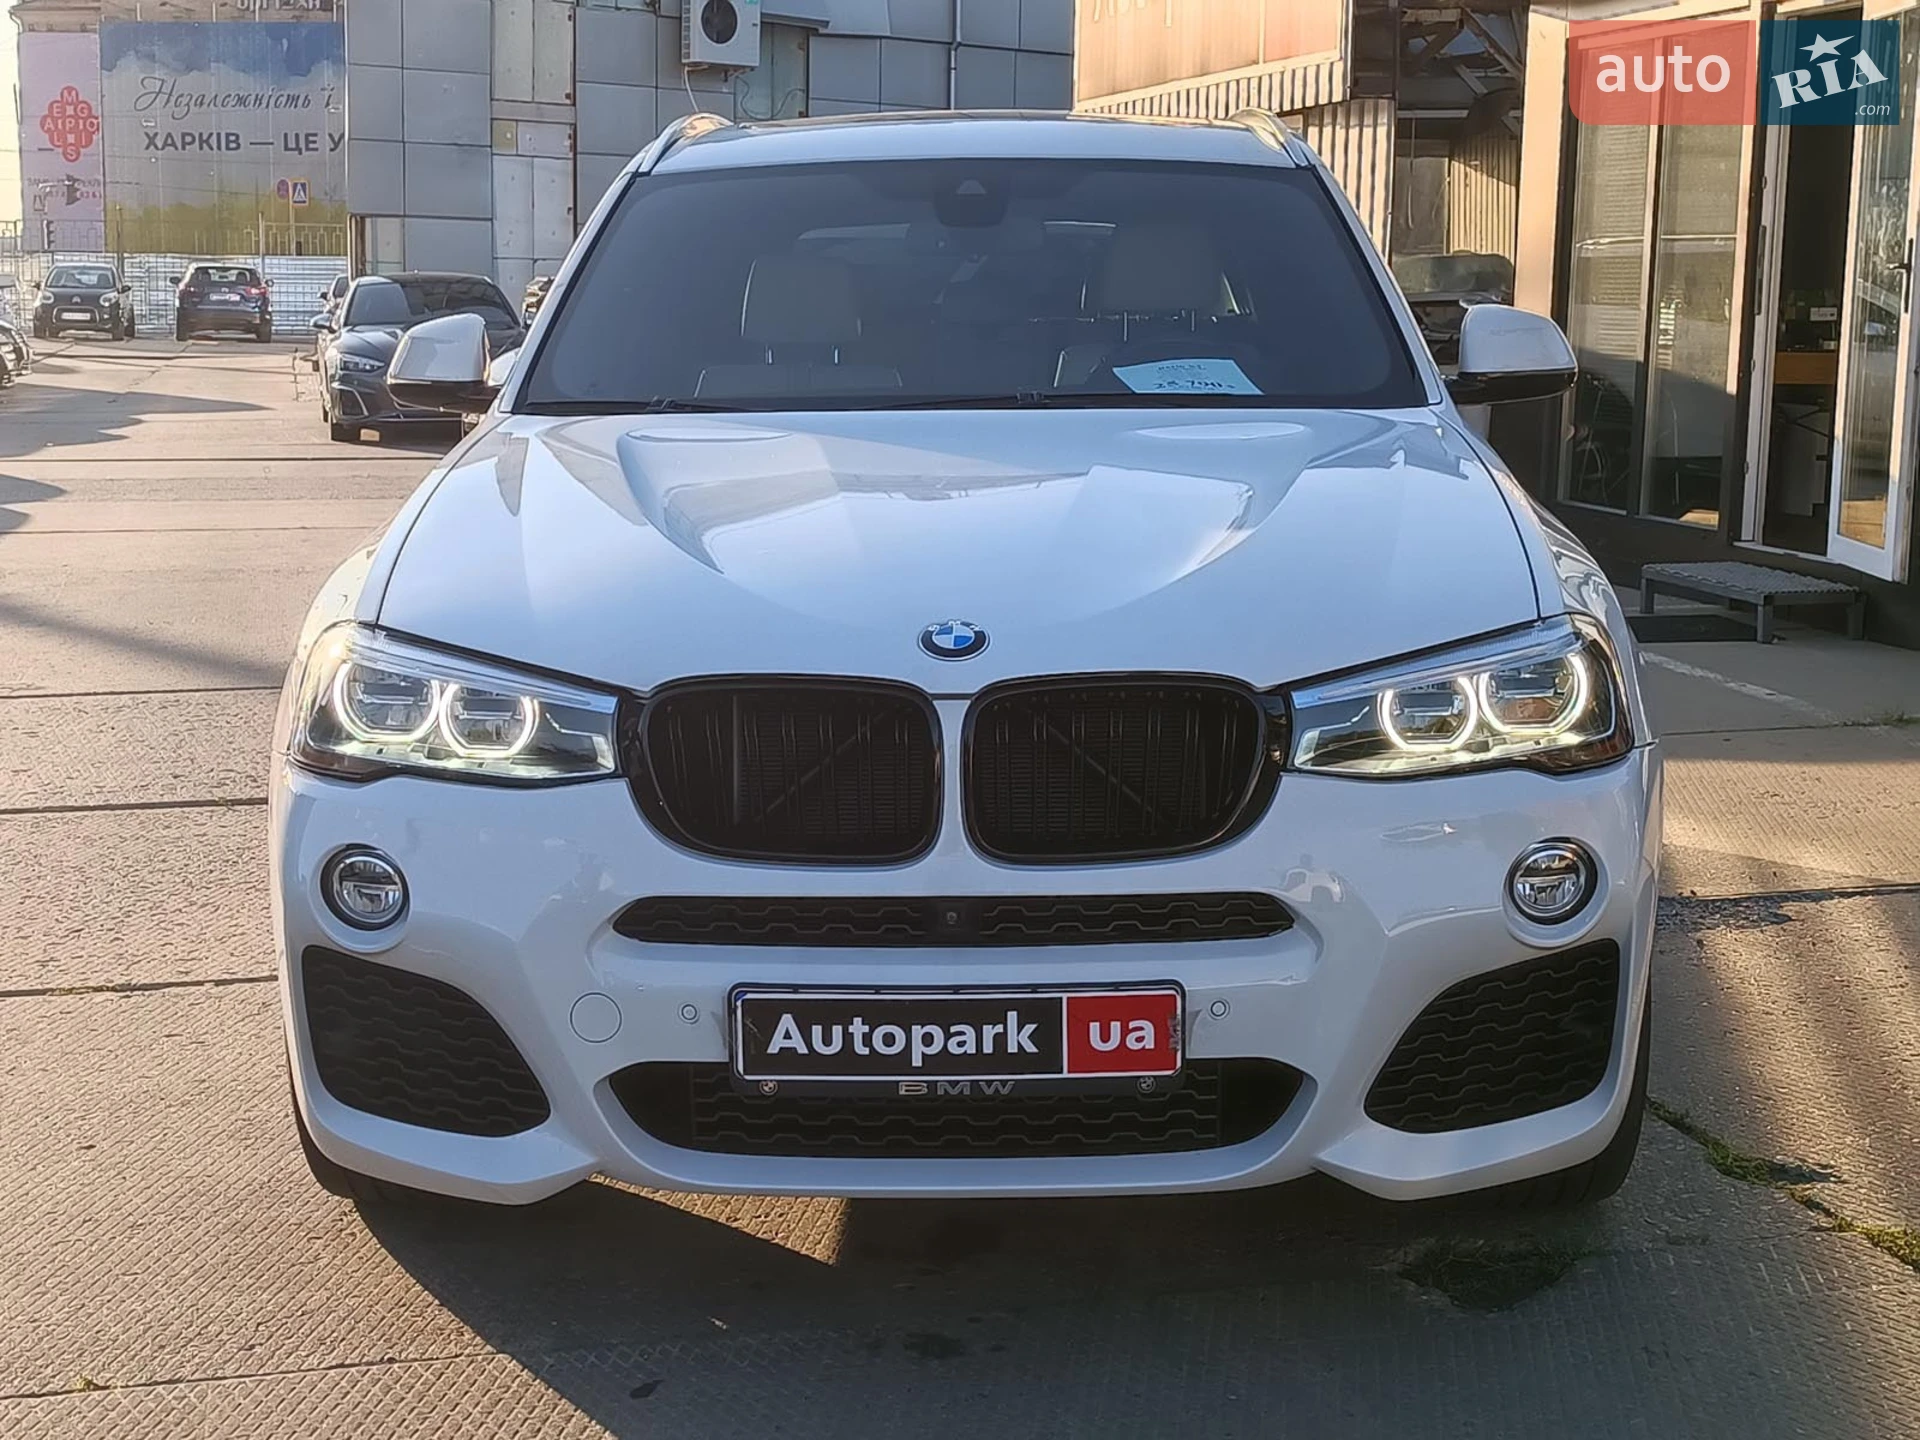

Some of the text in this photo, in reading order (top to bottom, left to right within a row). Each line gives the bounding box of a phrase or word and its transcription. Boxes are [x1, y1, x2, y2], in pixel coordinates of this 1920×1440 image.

[134, 76, 311, 120] Незалежність
[144, 132, 241, 151] ХАРКІВ
[283, 132, 319, 155] ЦЕ
[766, 1011, 1155, 1068] Autopark ua
[898, 1080, 1016, 1096] BMW
